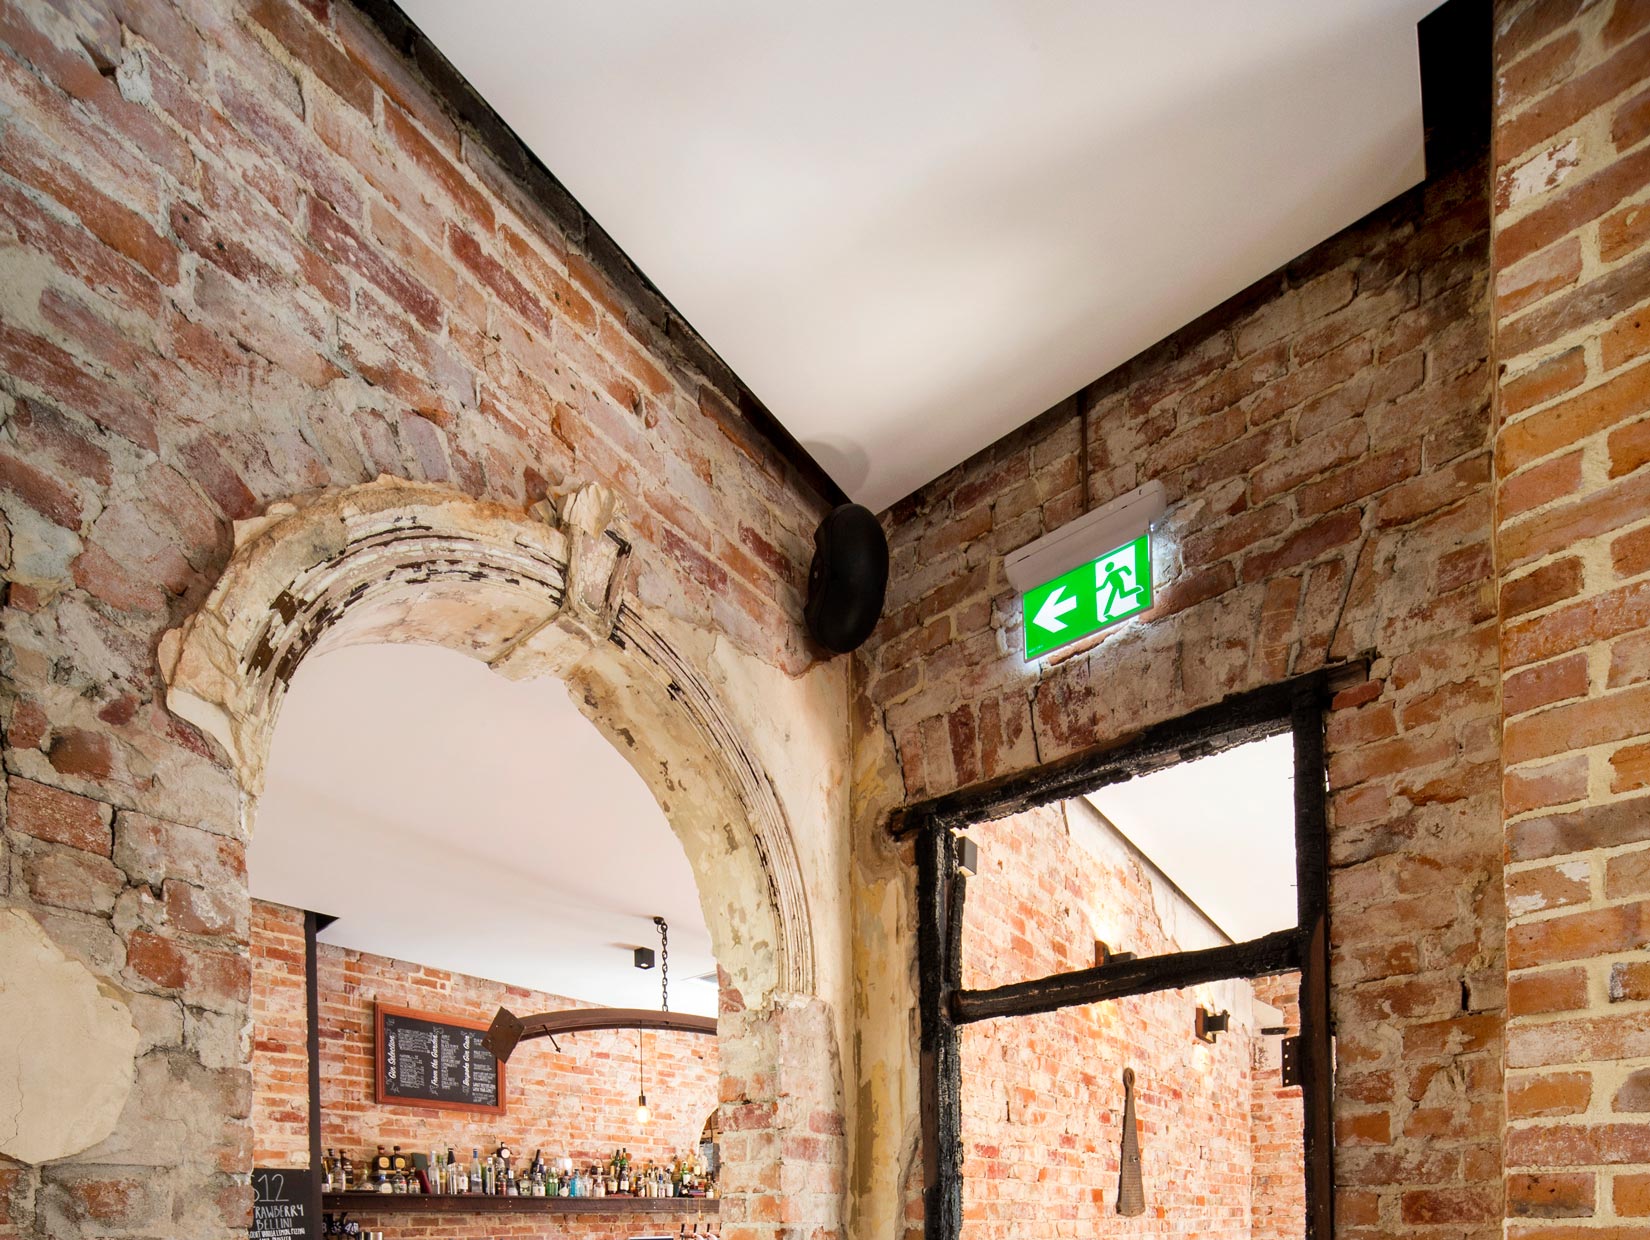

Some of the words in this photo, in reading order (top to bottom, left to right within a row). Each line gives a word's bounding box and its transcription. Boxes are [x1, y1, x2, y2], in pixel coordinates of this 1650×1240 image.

[388, 1035, 396, 1065] Selection
[388, 1066, 396, 1079] Gin
[430, 1070, 438, 1086] From
[254, 1204, 304, 1219] RAWBERRY
[256, 1218, 292, 1231] BELLINI
